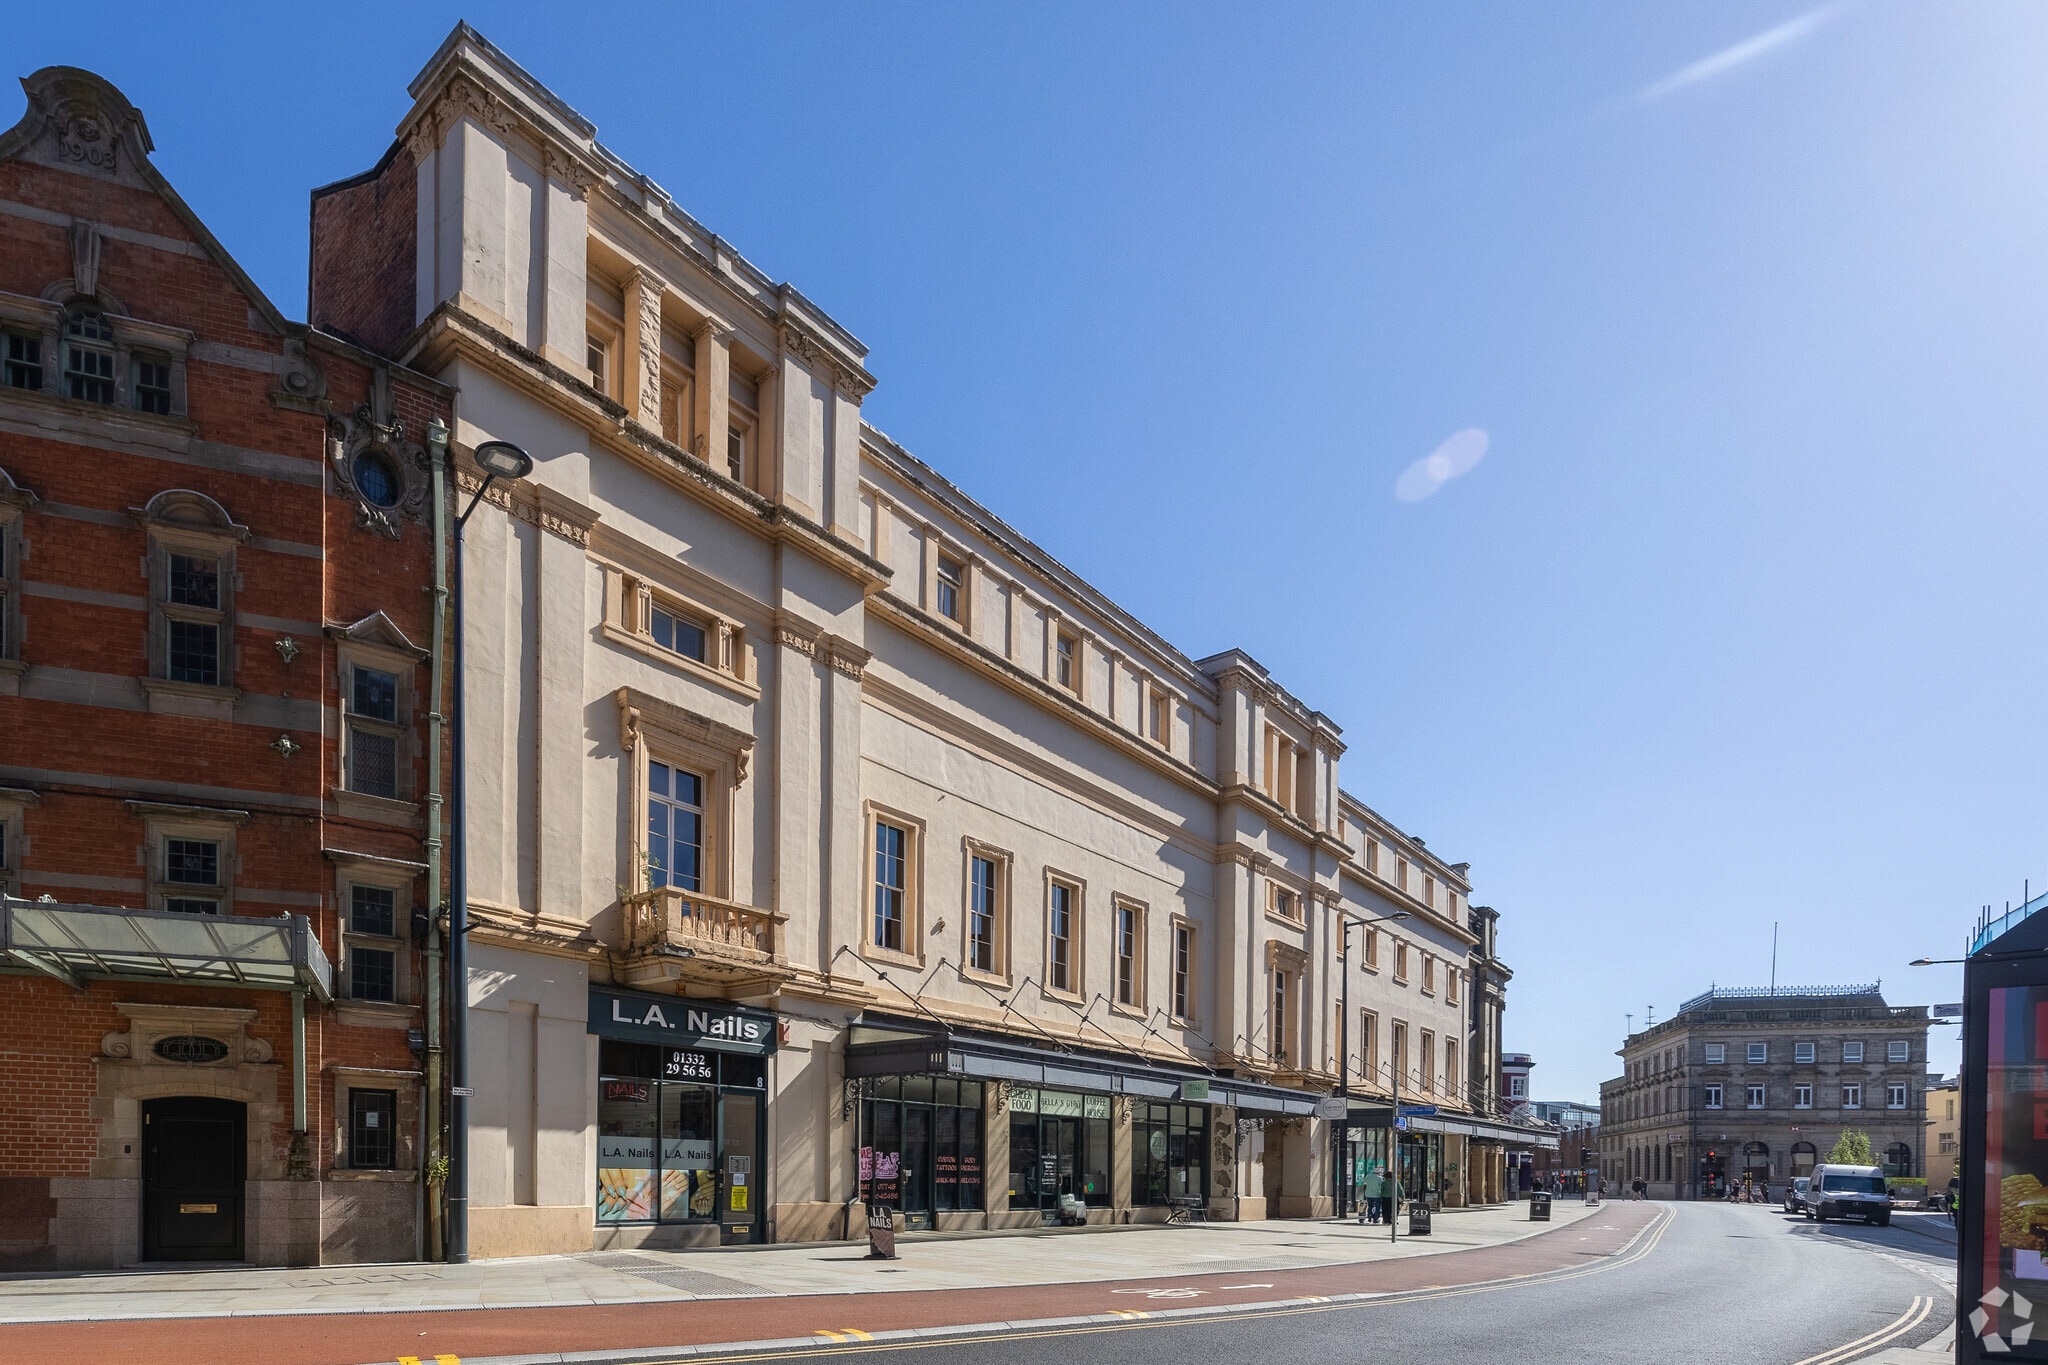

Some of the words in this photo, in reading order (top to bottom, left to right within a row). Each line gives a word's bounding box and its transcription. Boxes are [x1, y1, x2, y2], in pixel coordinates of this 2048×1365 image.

[612, 999, 676, 1029] L.A.
[687, 1009, 759, 1039] Nails
[673, 1051, 706, 1065] 01332
[666, 1063, 680, 1075] 29
[682, 1065, 696, 1077] 56
[698, 1066, 711, 1078] 56
[756, 1077, 763, 1088] 8
[608, 1083, 648, 1098] NAILS
[1011, 1099, 1032, 1110] FOOD
[1086, 1096, 1107, 1107] COFFEE
[1086, 1108, 1106, 1118] HOUSE
[602, 1147, 625, 1157] L.A.
[628, 1148, 655, 1159] Nails
[664, 1149, 684, 1159] L.A.
[687, 1150, 712, 1160] Nails
[872, 1207, 887, 1218] L.A.
[870, 1217, 892, 1229] NAILS
